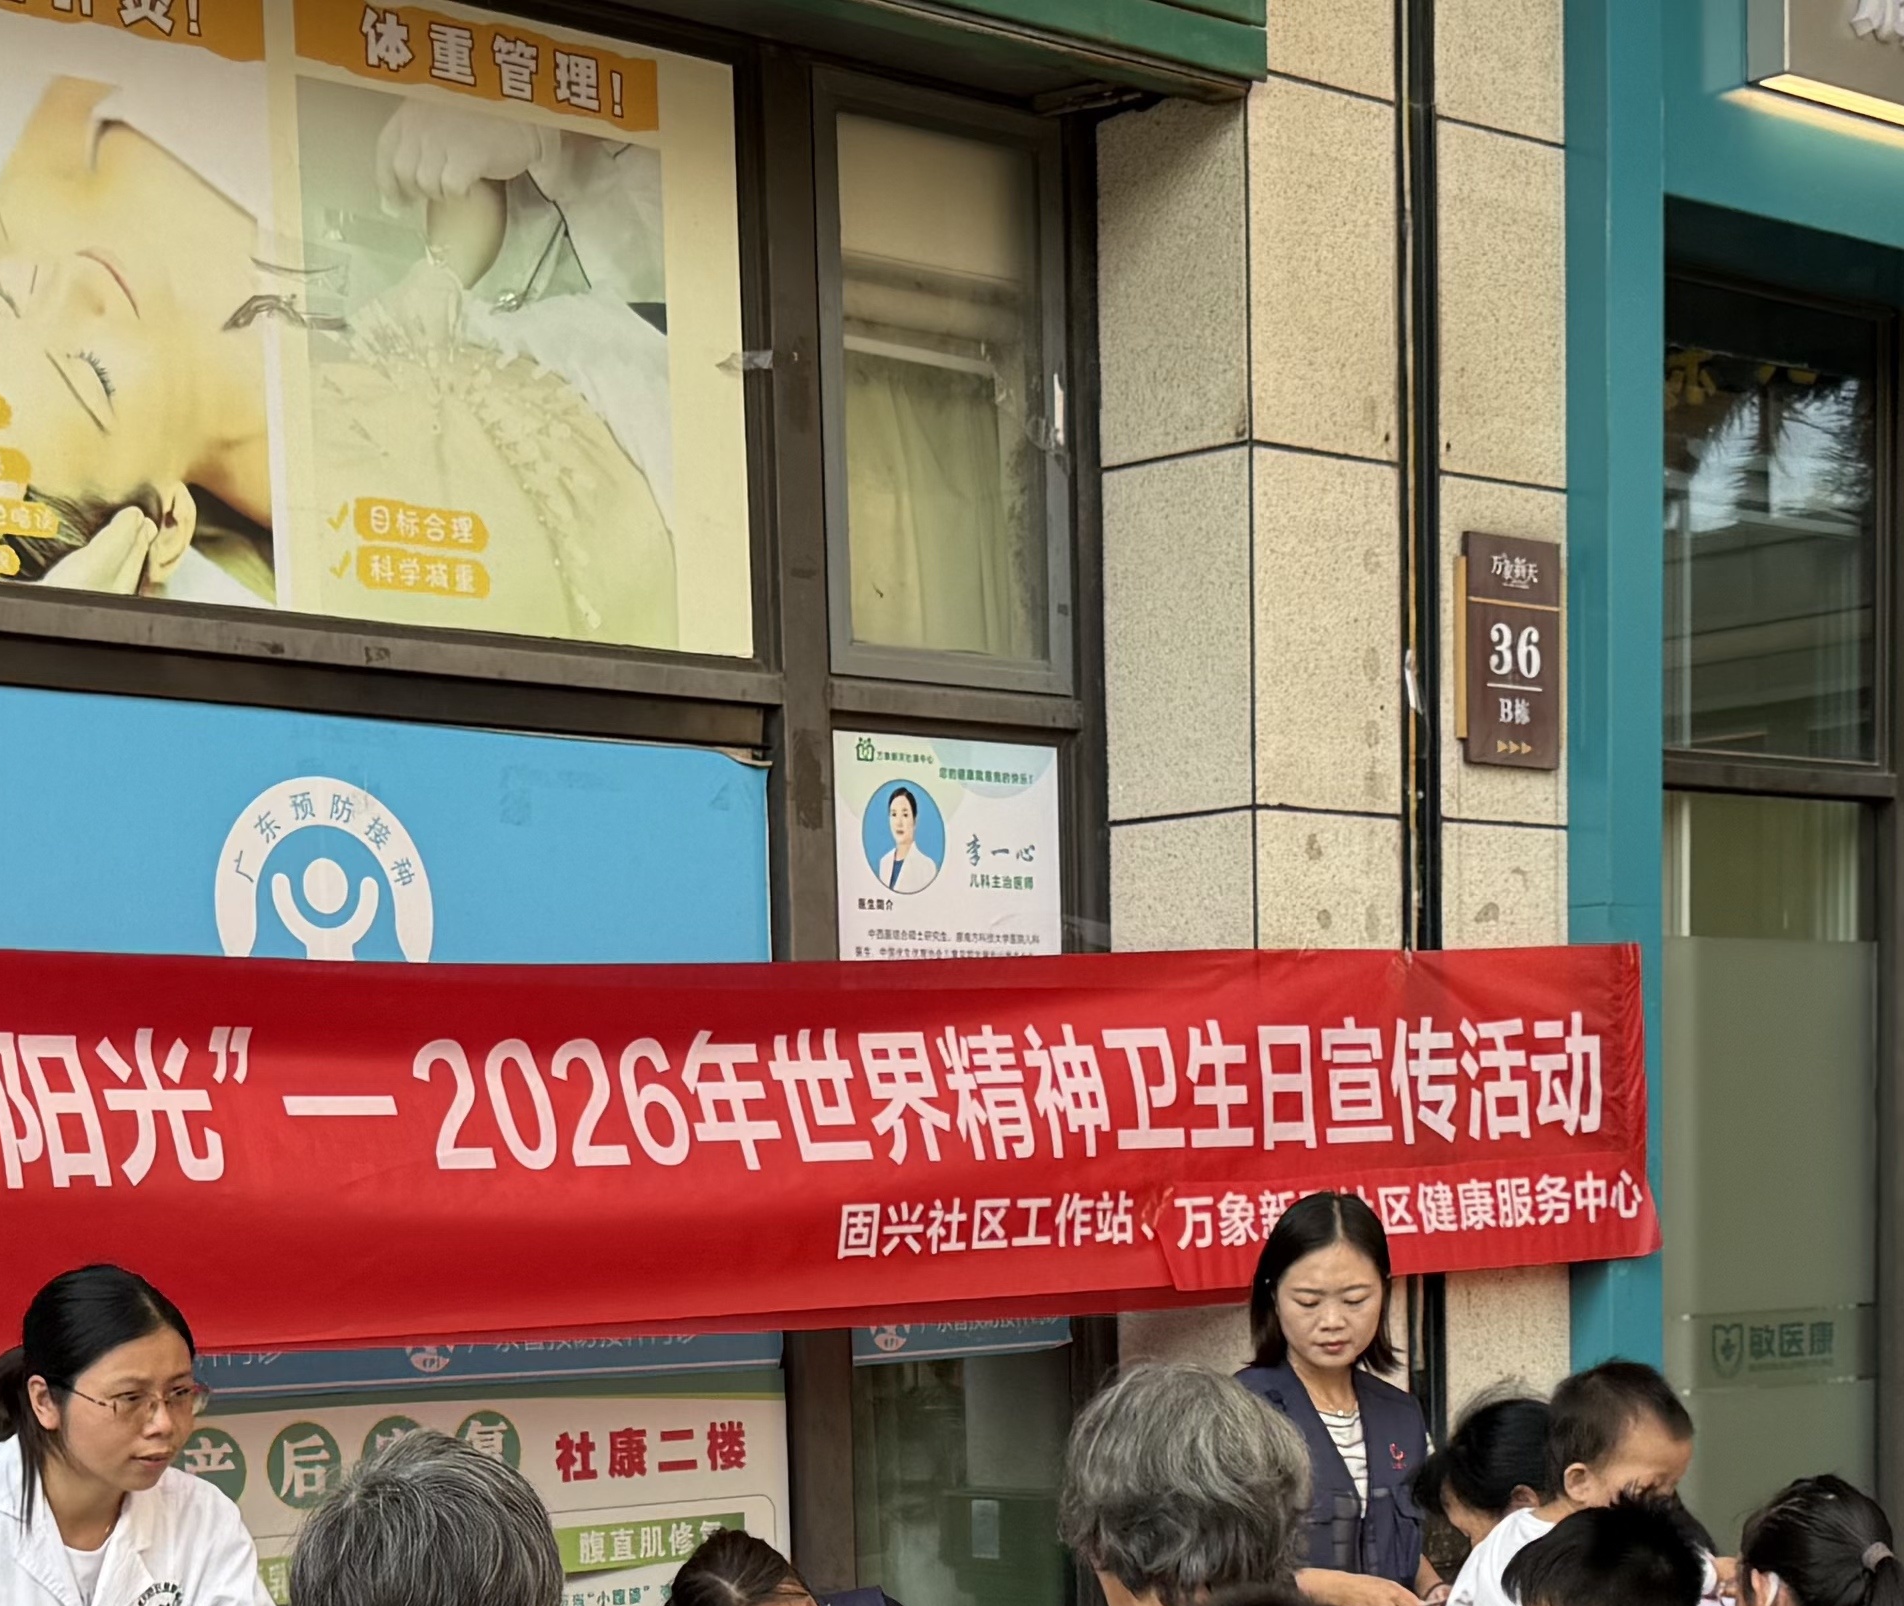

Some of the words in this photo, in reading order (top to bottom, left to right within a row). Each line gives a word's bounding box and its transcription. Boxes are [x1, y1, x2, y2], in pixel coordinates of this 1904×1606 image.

[370, 505, 475, 543] 目标合理
[370, 554, 476, 592] 科学减重
[1489, 622, 1542, 679] 36
[1499, 698, 1531, 726] B栋
[233, 791, 415, 887] 广东预防接种
[965, 833, 1036, 867] 李一心
[969, 872, 1035, 891] 儿科主治医师
[857, 897, 895, 912] 医生简介
[836, 1169, 1644, 1260] 固兴社区工作站、万象新区健康服务中心
[1749, 1322, 1834, 1359] 敏医康
[555, 1420, 747, 1483] 社康二楼
